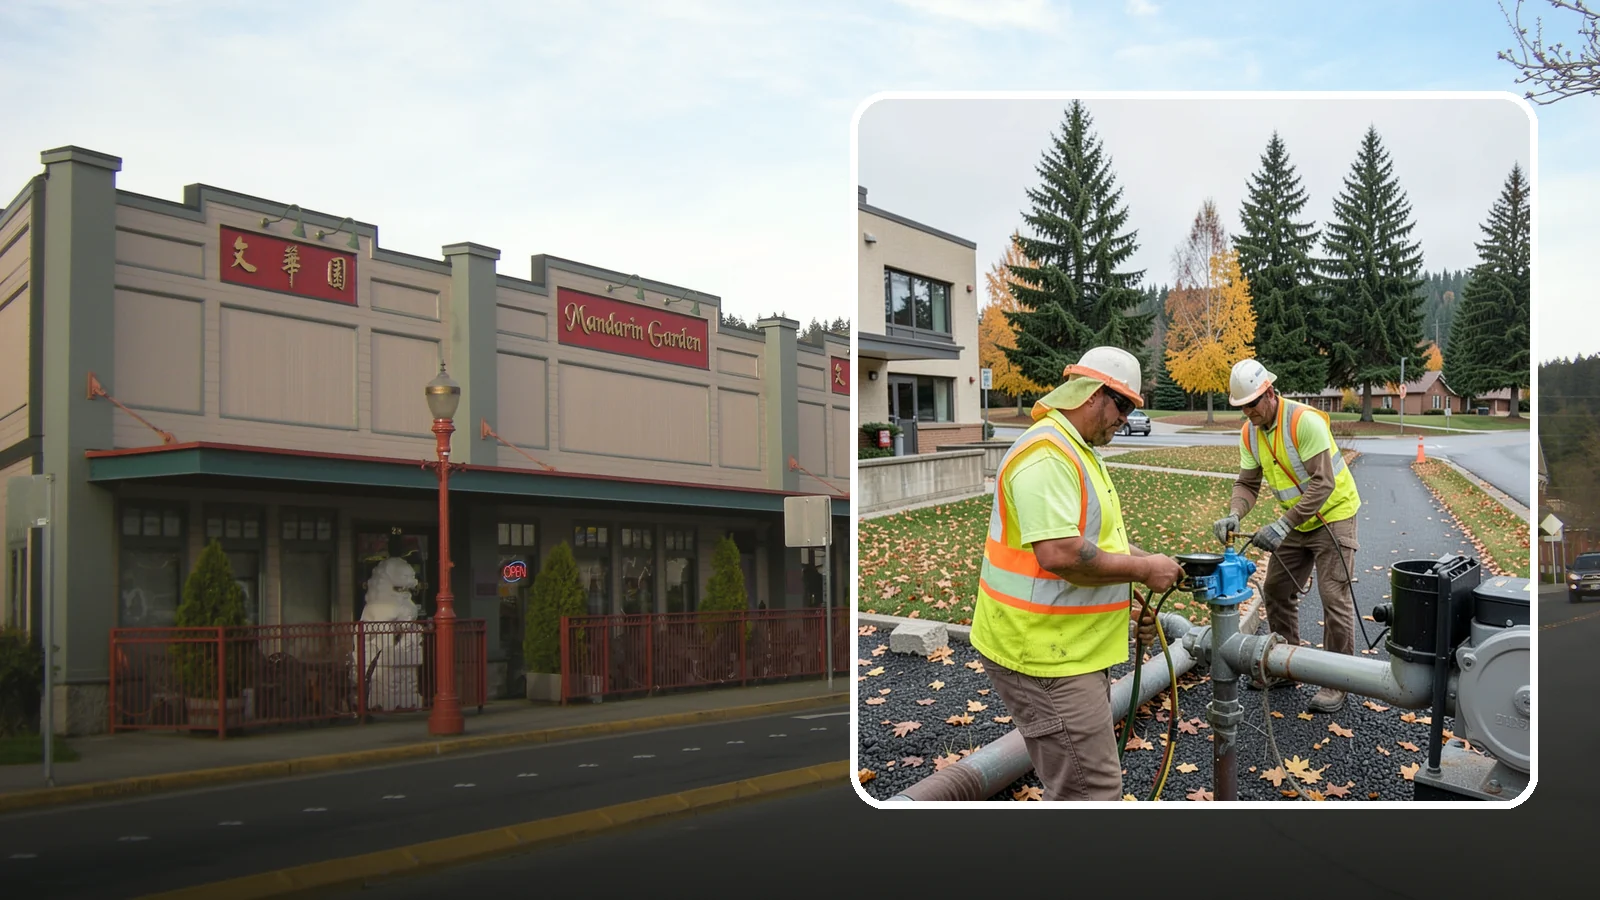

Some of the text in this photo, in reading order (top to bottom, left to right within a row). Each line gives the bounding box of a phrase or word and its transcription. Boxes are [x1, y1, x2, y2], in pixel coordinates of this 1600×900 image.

[230, 235, 347, 291] 文華園
[564, 302, 701, 352] Mandarin Garden
[503, 565, 527, 578] OPEN
